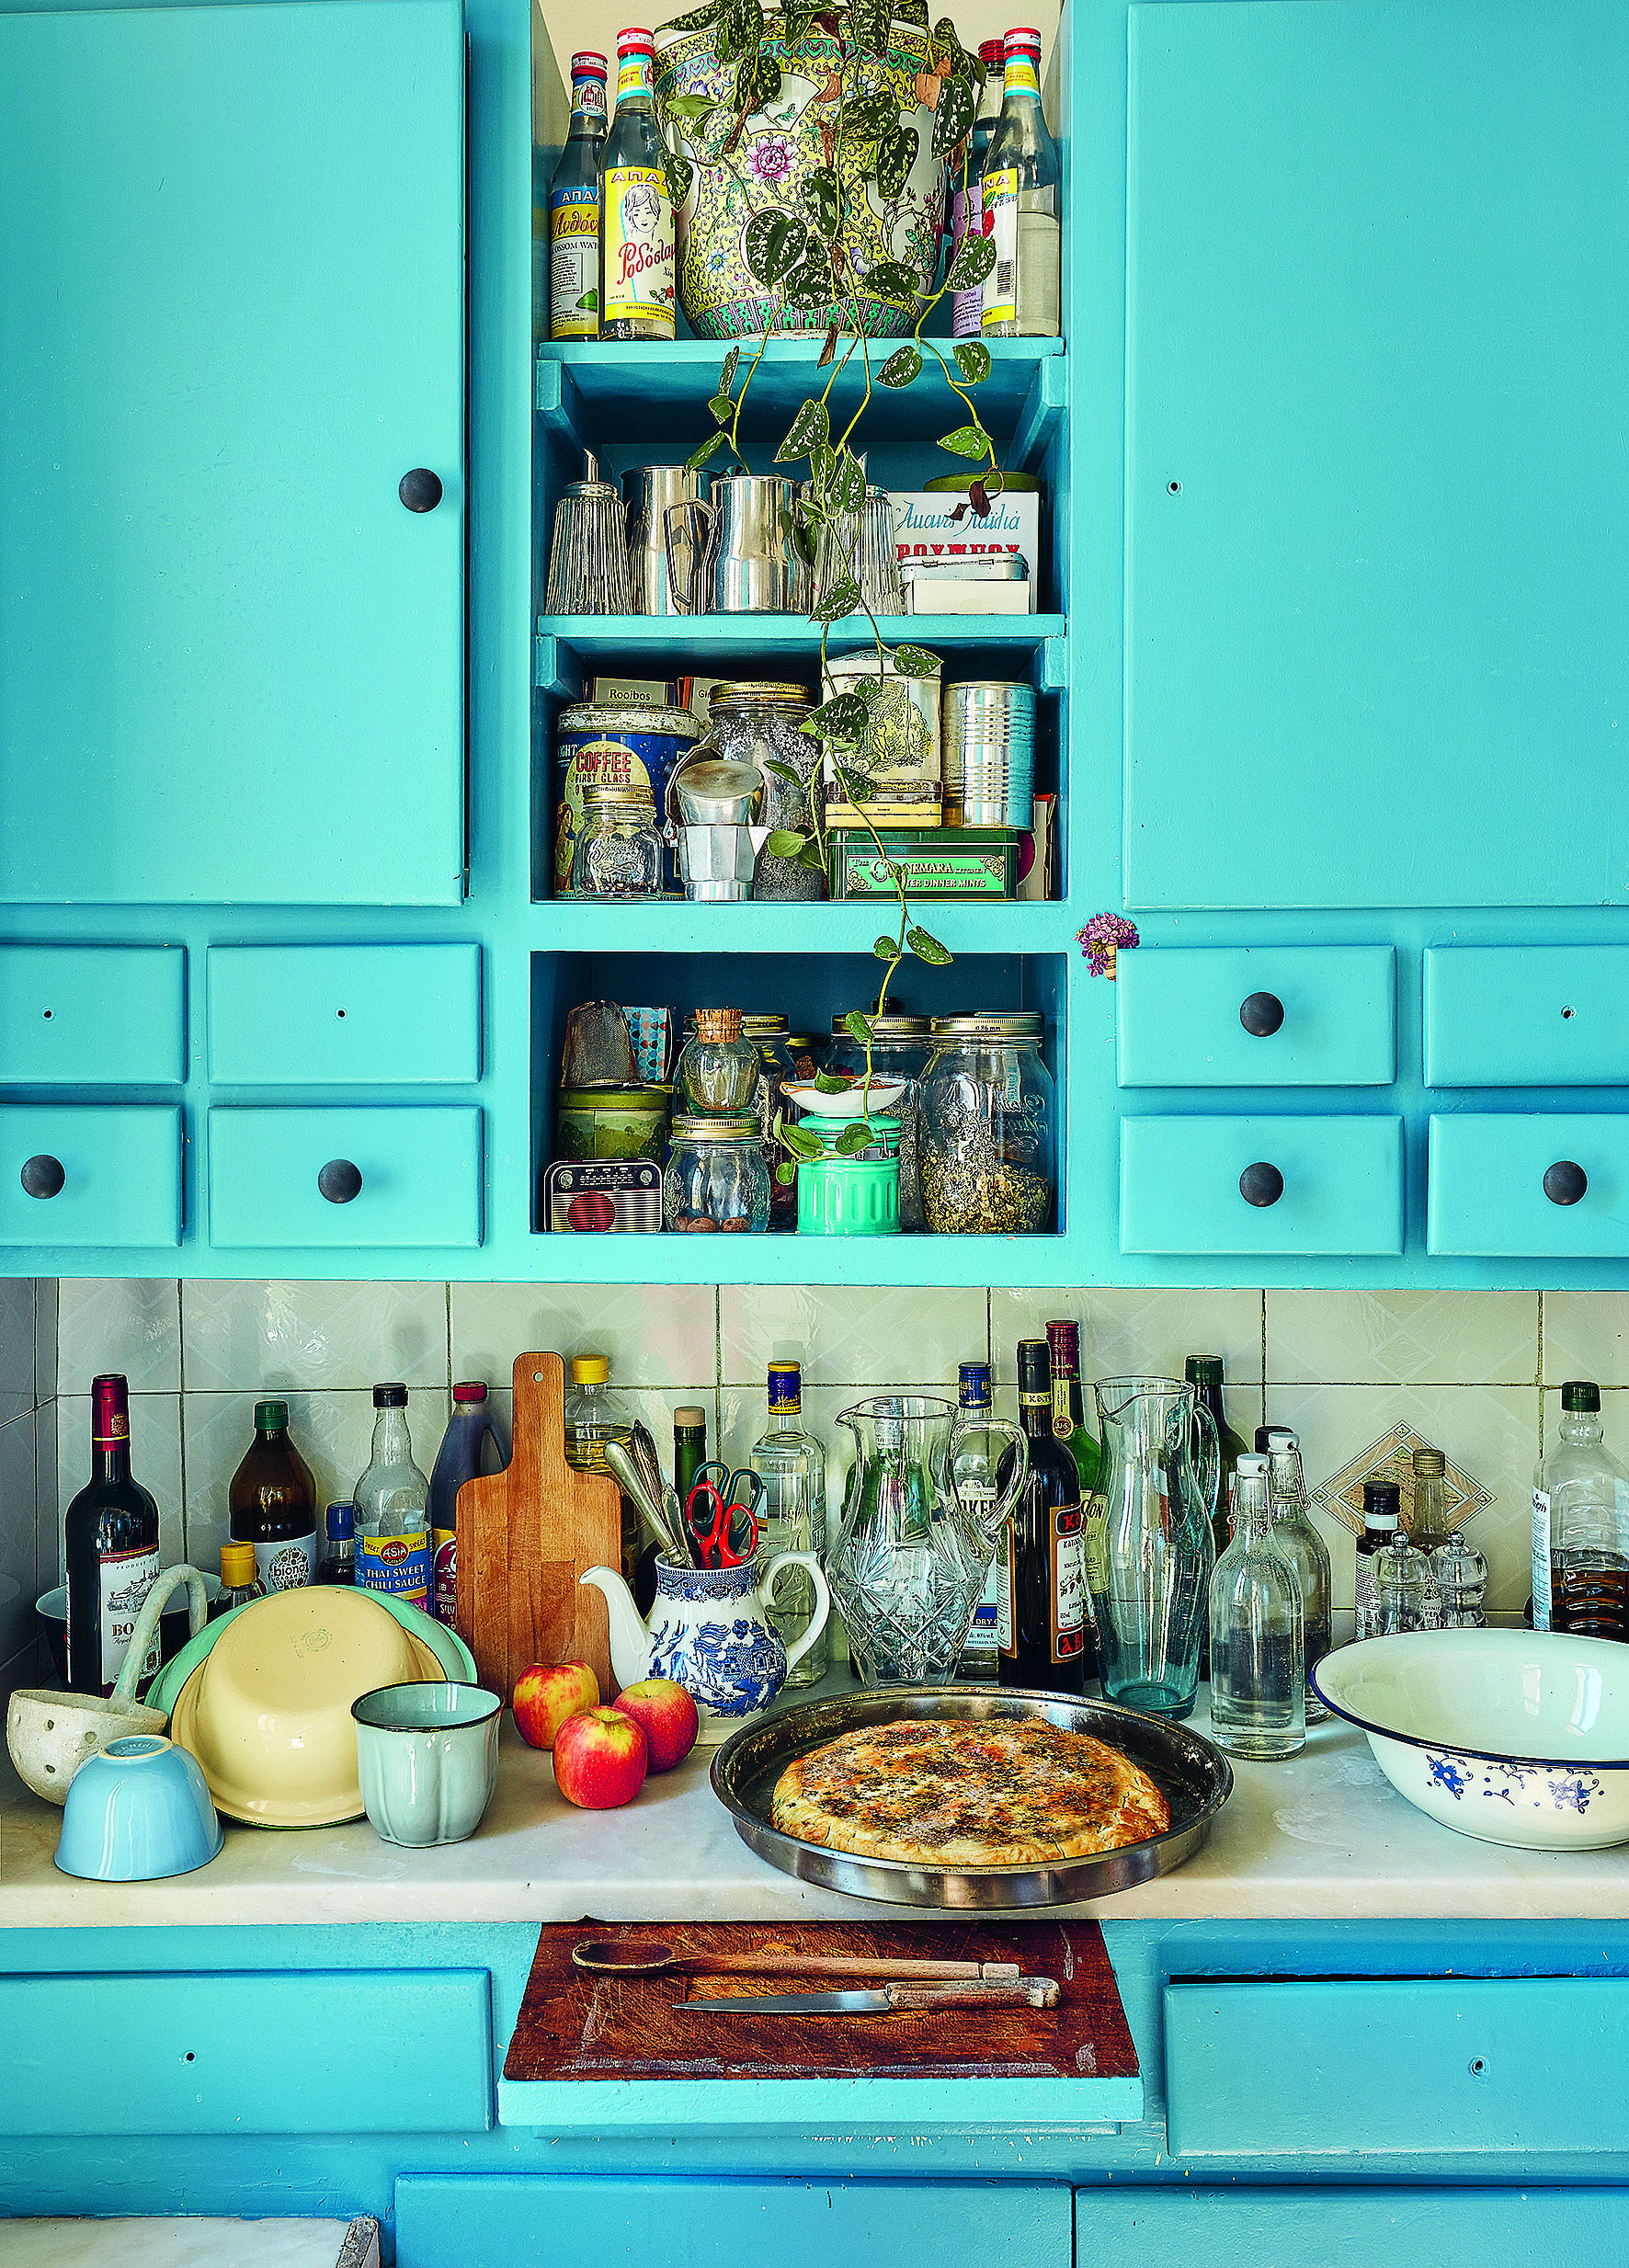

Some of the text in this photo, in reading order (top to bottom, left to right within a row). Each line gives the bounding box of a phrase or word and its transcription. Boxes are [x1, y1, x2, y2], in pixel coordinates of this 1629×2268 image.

[609, 689, 651, 701] Rooibos
[576, 751, 632, 772] COFFEE
[575, 772, 632, 783] FIRST CLASS
[924, 879, 957, 888] DINNER
[958, 879, 986, 888] MINTS
[382, 1546, 407, 1558] ASIA
[273, 1564, 305, 1578] biona
[366, 1564, 426, 1579] THAI SWEET
[365, 1574, 427, 1590] CHILI SAUCE
